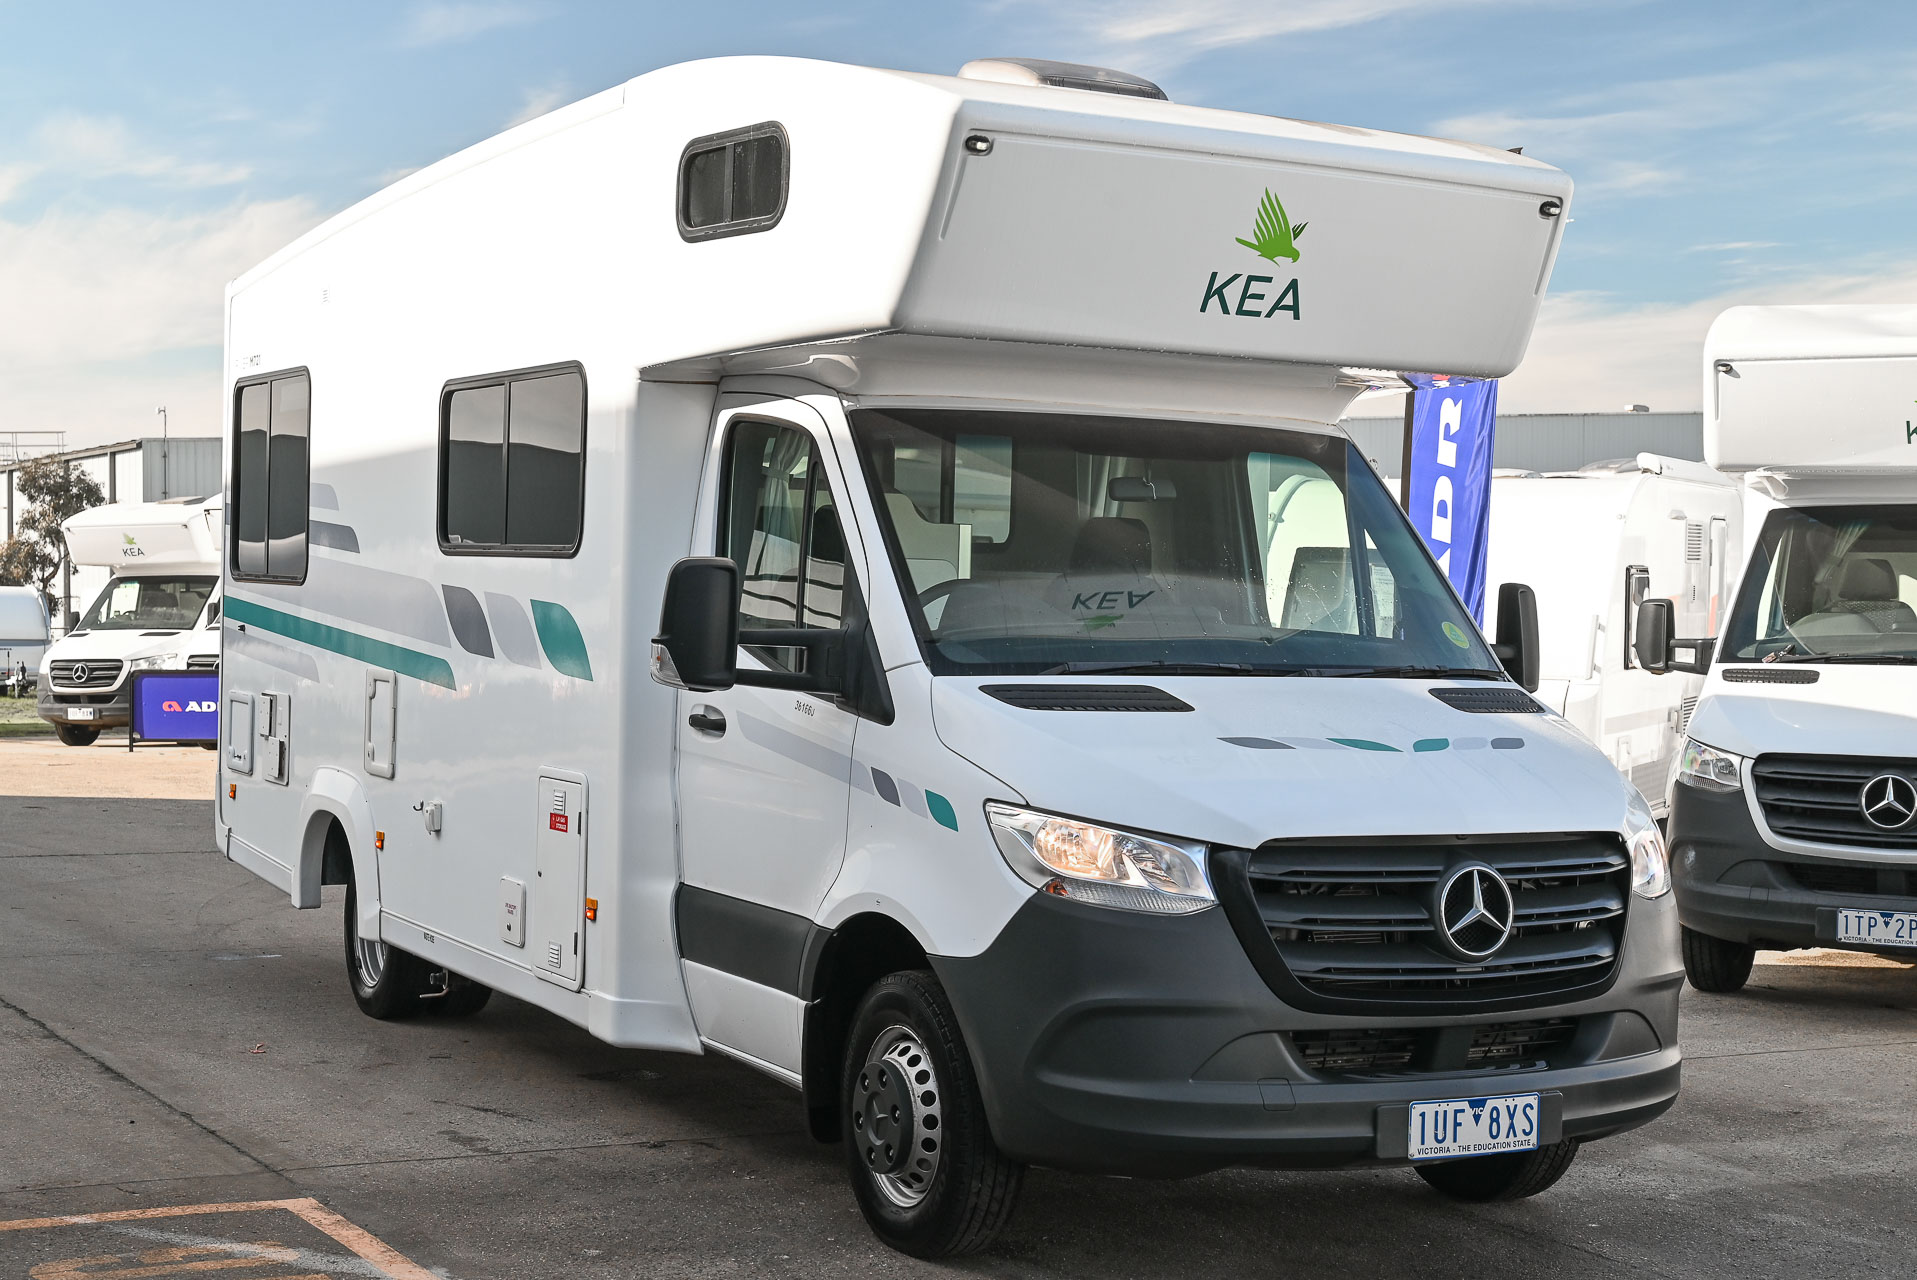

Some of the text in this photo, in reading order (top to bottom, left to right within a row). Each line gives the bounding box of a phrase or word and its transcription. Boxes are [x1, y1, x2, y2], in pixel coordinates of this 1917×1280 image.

[1199, 271, 1301, 321] KEA
[122, 547, 145, 557] KEA
[184, 701, 218, 712] AD
[1844, 915, 1877, 936] 1TP
[1418, 1103, 1534, 1145] 1UF 8XS
[1417, 1146, 1451, 1156] VICTORIA
[1457, 1144, 1472, 1153] THE
[1474, 1141, 1511, 1151] EDUCATION
[1513, 1139, 1531, 1148] STATE
